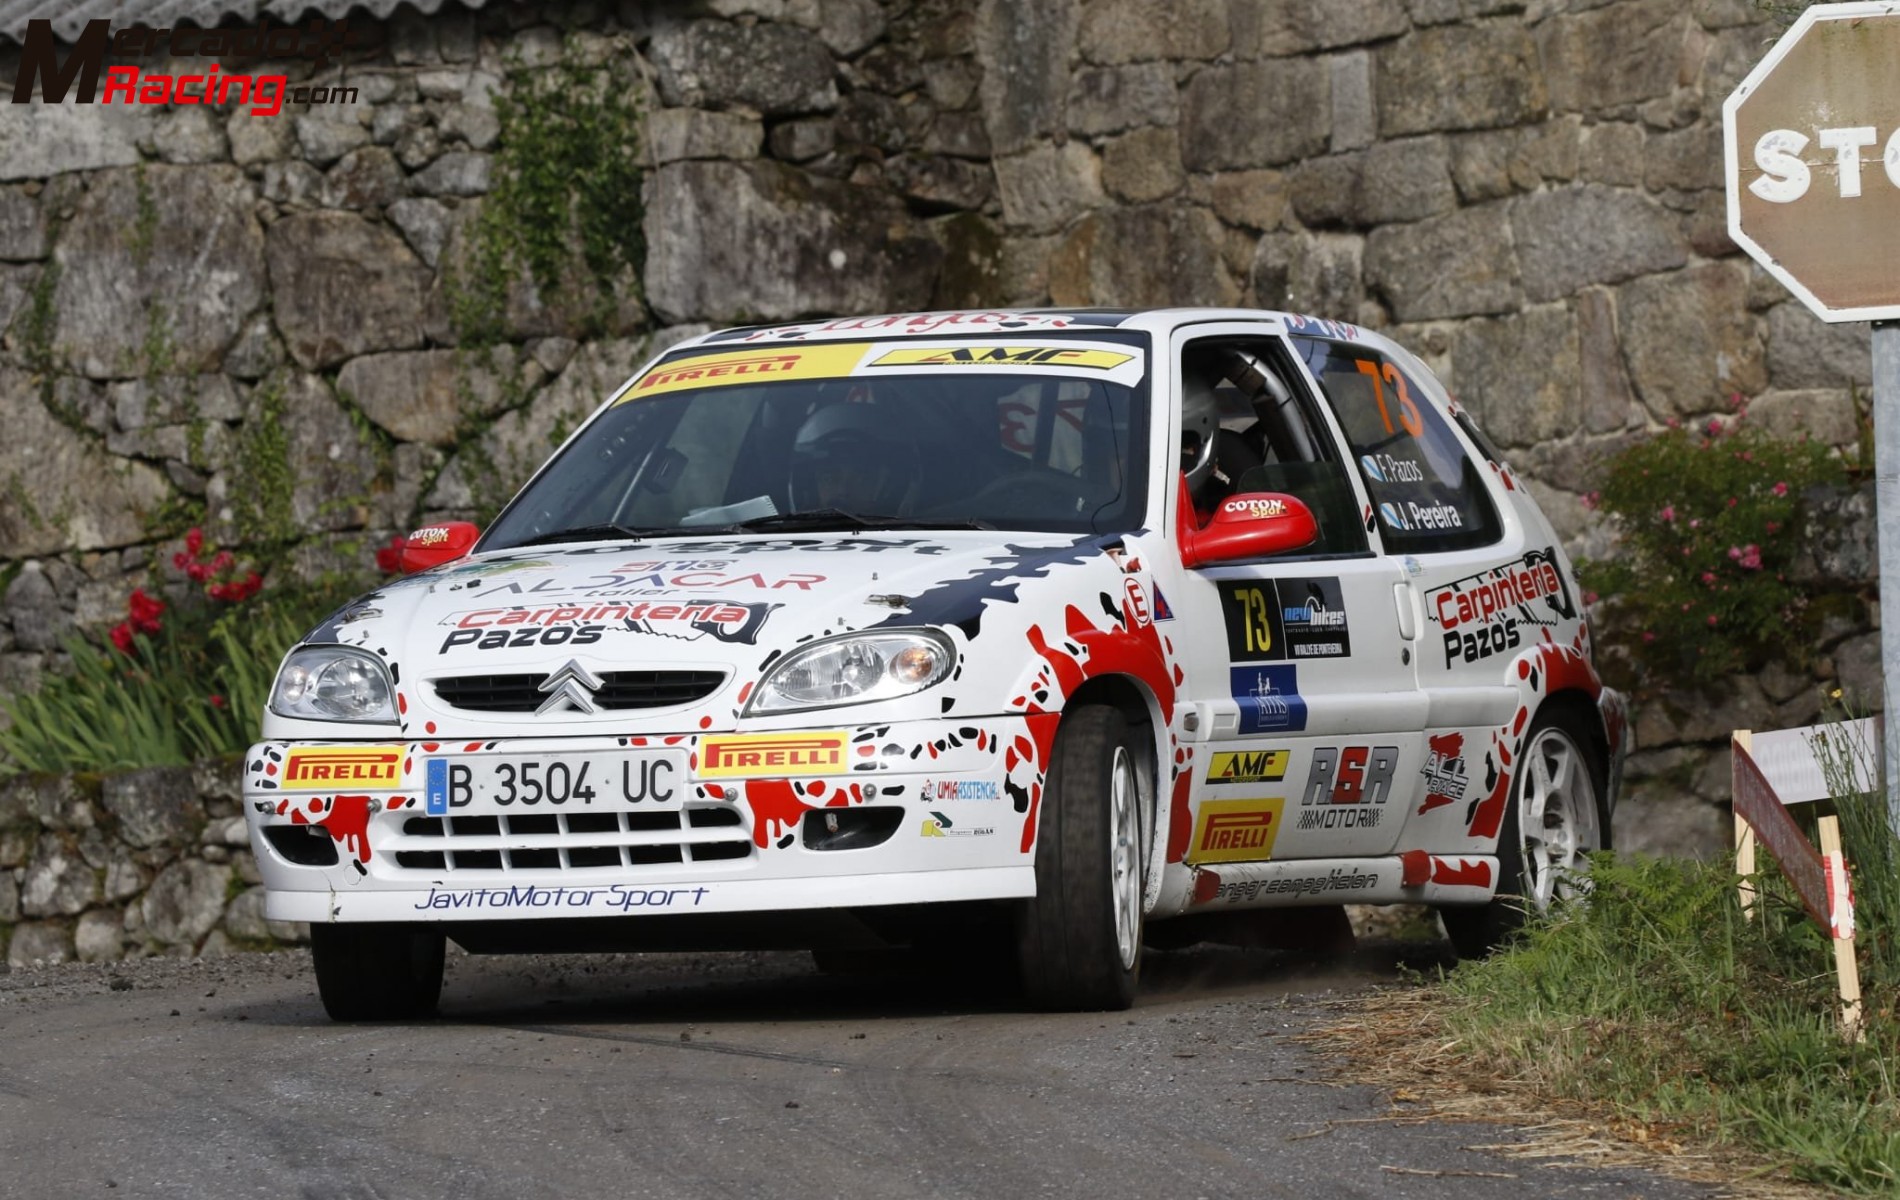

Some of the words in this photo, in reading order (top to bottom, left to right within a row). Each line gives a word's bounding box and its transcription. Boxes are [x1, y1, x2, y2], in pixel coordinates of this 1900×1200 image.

[1748, 126, 1900, 203] ST
[917, 347, 1086, 363] AMF
[638, 354, 801, 390] PIRELLI
[1355, 359, 1424, 438] 73
[1224, 499, 1282, 513] COTON
[1408, 500, 1462, 530] Pereira
[409, 528, 450, 540] COTON
[421, 533, 449, 546] Sport
[472, 573, 828, 598] ALDACAR
[1127, 582, 1148, 618] E
[1234, 588, 1272, 652] 73
[439, 625, 607, 655] Pazos
[1443, 618, 1521, 670] Pazos
[286, 753, 399, 780] PIRELLI
[705, 739, 842, 769] PIRELLI
[1222, 752, 1276, 777] AMF
[1420, 750, 1469, 786] ALL
[449, 765, 473, 807] B
[493, 761, 596, 806] 3504
[623, 759, 673, 803] UC
[1428, 777, 1467, 800] RACE
[433, 794, 441, 805] E
[1200, 811, 1272, 851] PIRELLI
[1314, 808, 1369, 828] MOTOR
